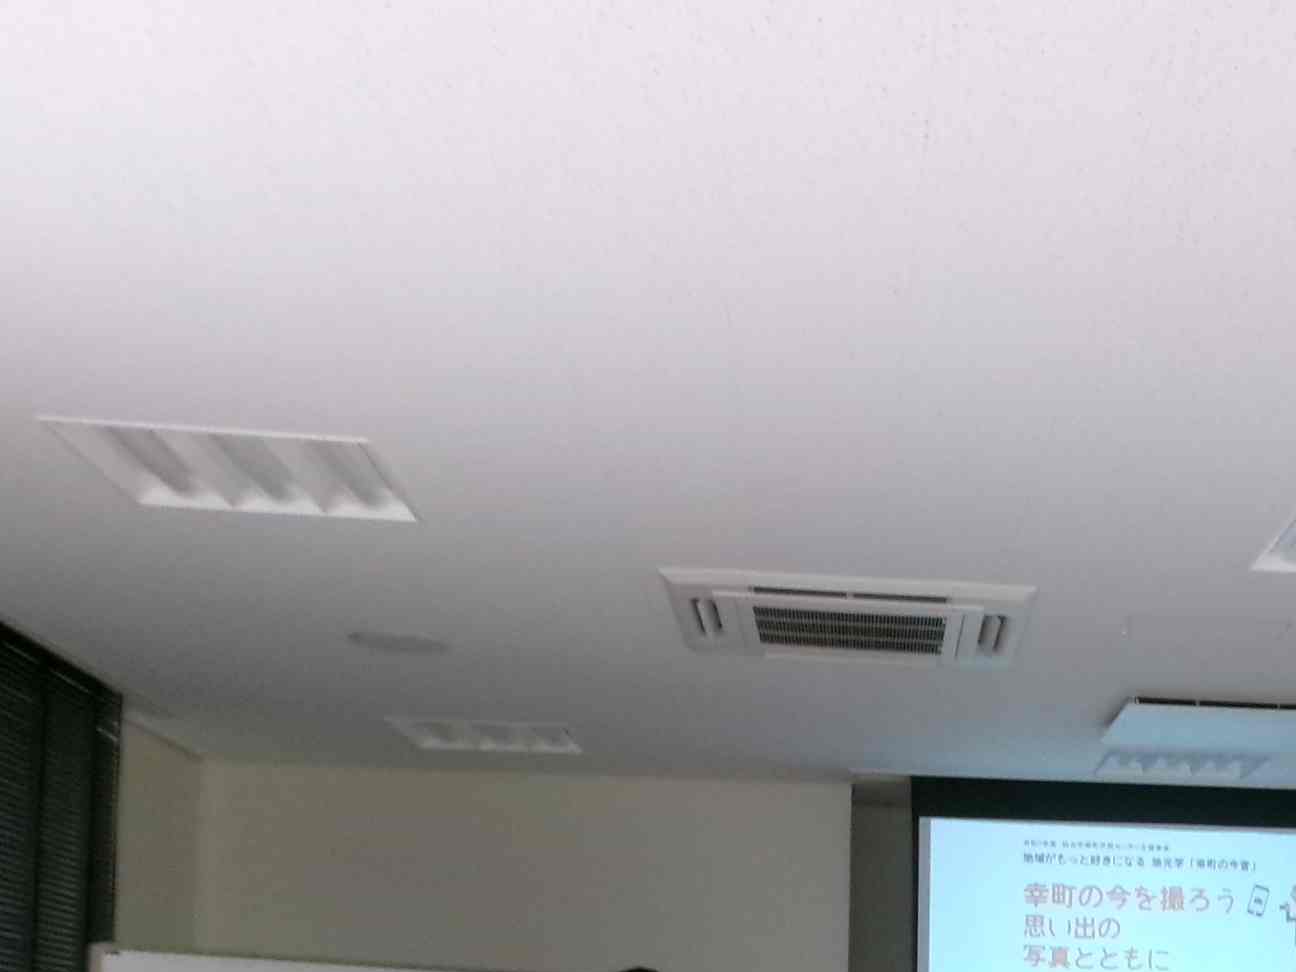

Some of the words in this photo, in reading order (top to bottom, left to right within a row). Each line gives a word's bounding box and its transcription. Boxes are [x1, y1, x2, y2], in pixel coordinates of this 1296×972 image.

[1024, 883, 1234, 914] 幸町の今を撮ろう
[1024, 914, 1121, 939] 思い出の
[1023, 944, 1169, 971] 写真とともに
